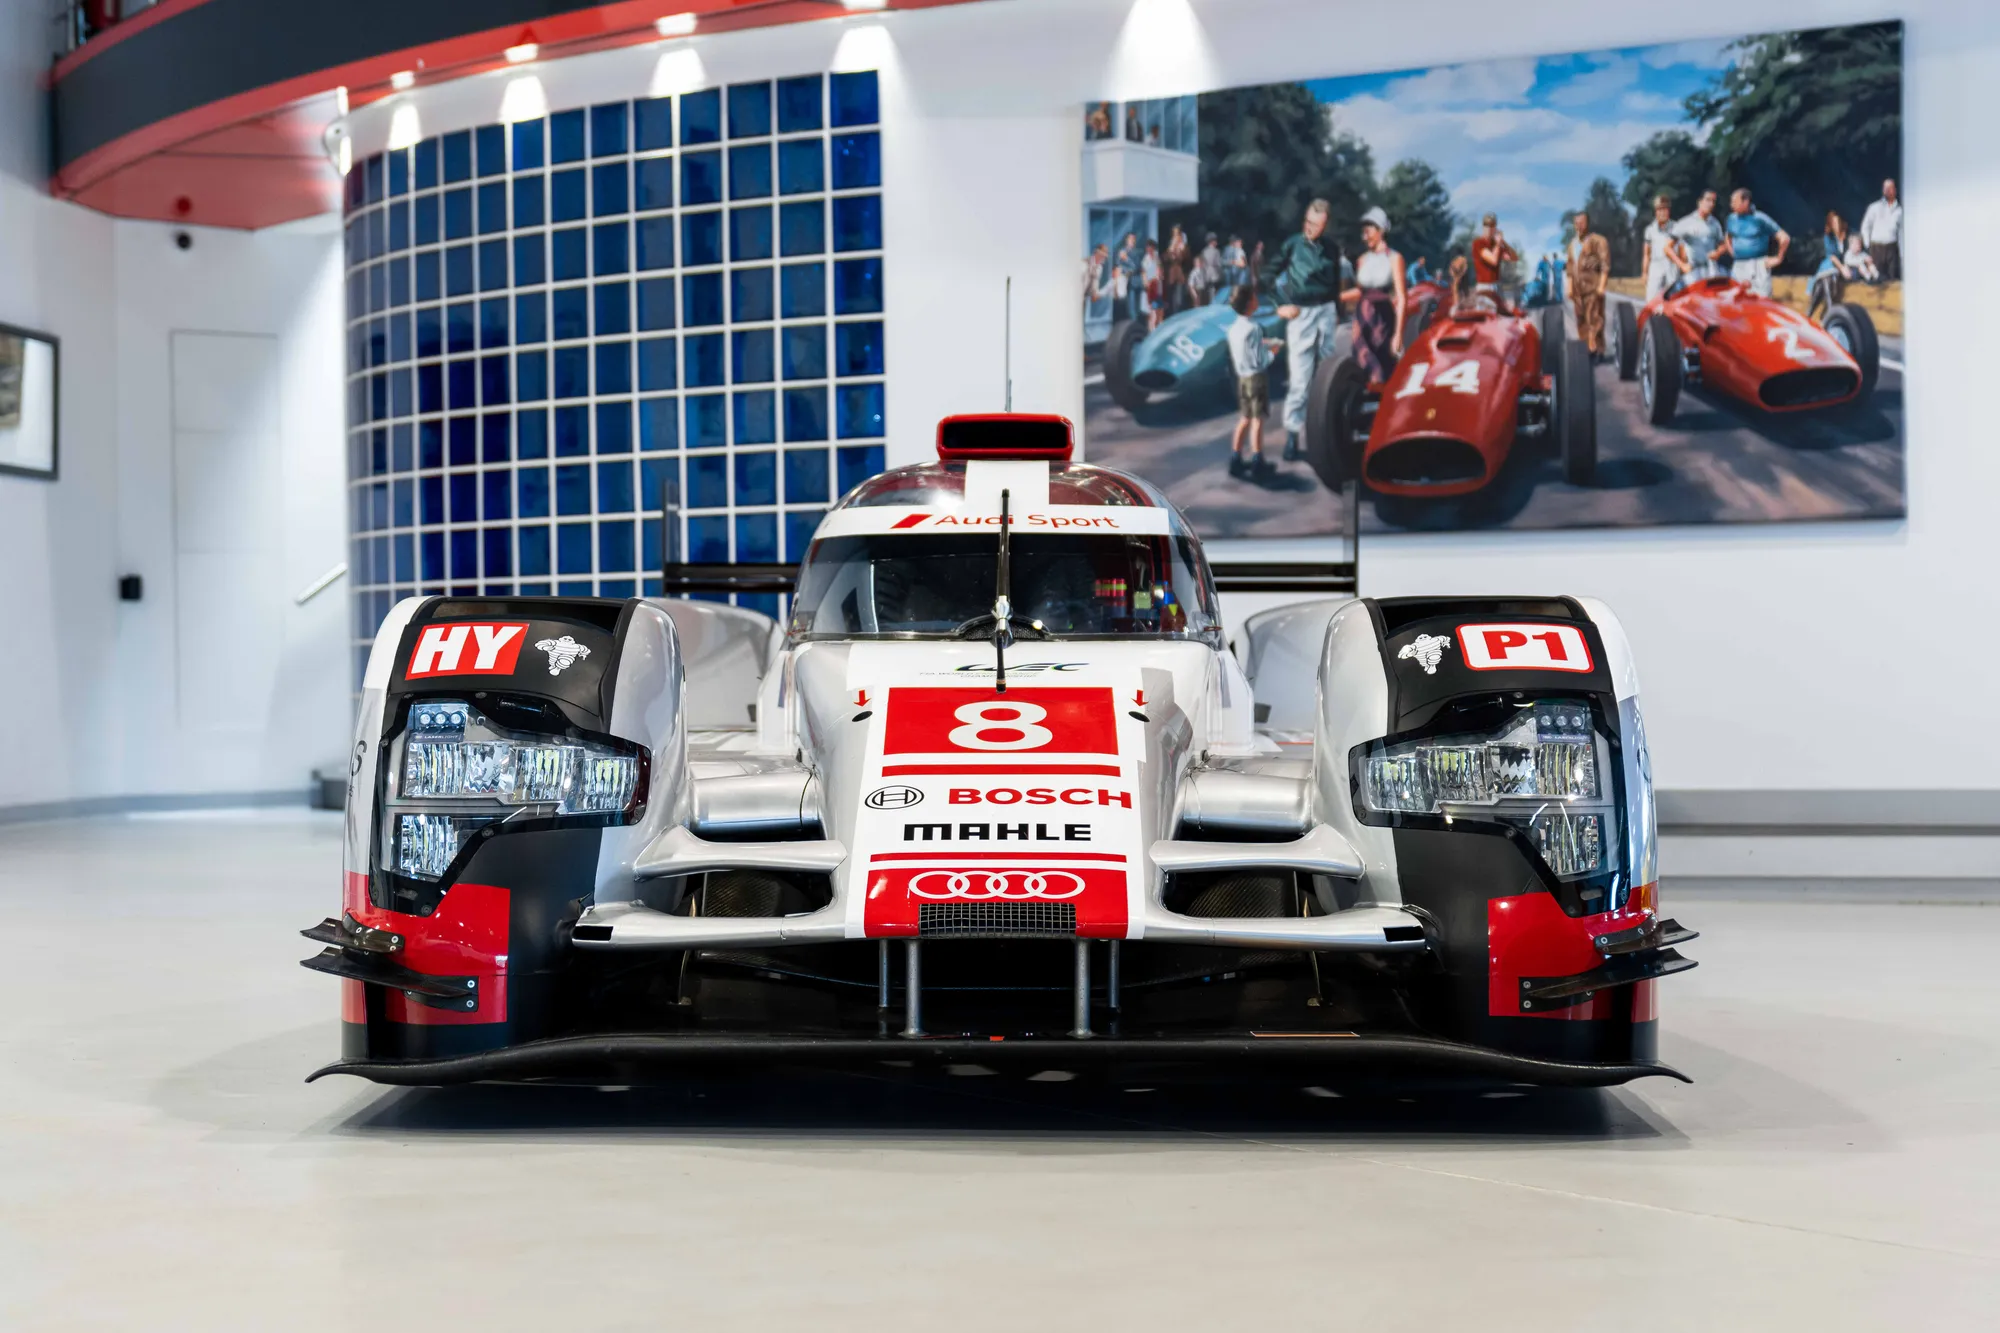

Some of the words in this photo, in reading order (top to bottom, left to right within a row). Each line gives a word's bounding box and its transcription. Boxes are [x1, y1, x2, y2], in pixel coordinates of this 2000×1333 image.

[1167, 335, 1204, 363] 18
[1767, 327, 1816, 358] 2
[1394, 360, 1480, 399] 14
[1028, 513, 1120, 528] Sport
[411, 625, 523, 674] HY
[1482, 631, 1568, 661] P1
[948, 700, 1053, 750] 8
[948, 788, 1132, 809] BOSCH
[903, 823, 1091, 841] MAHLE
